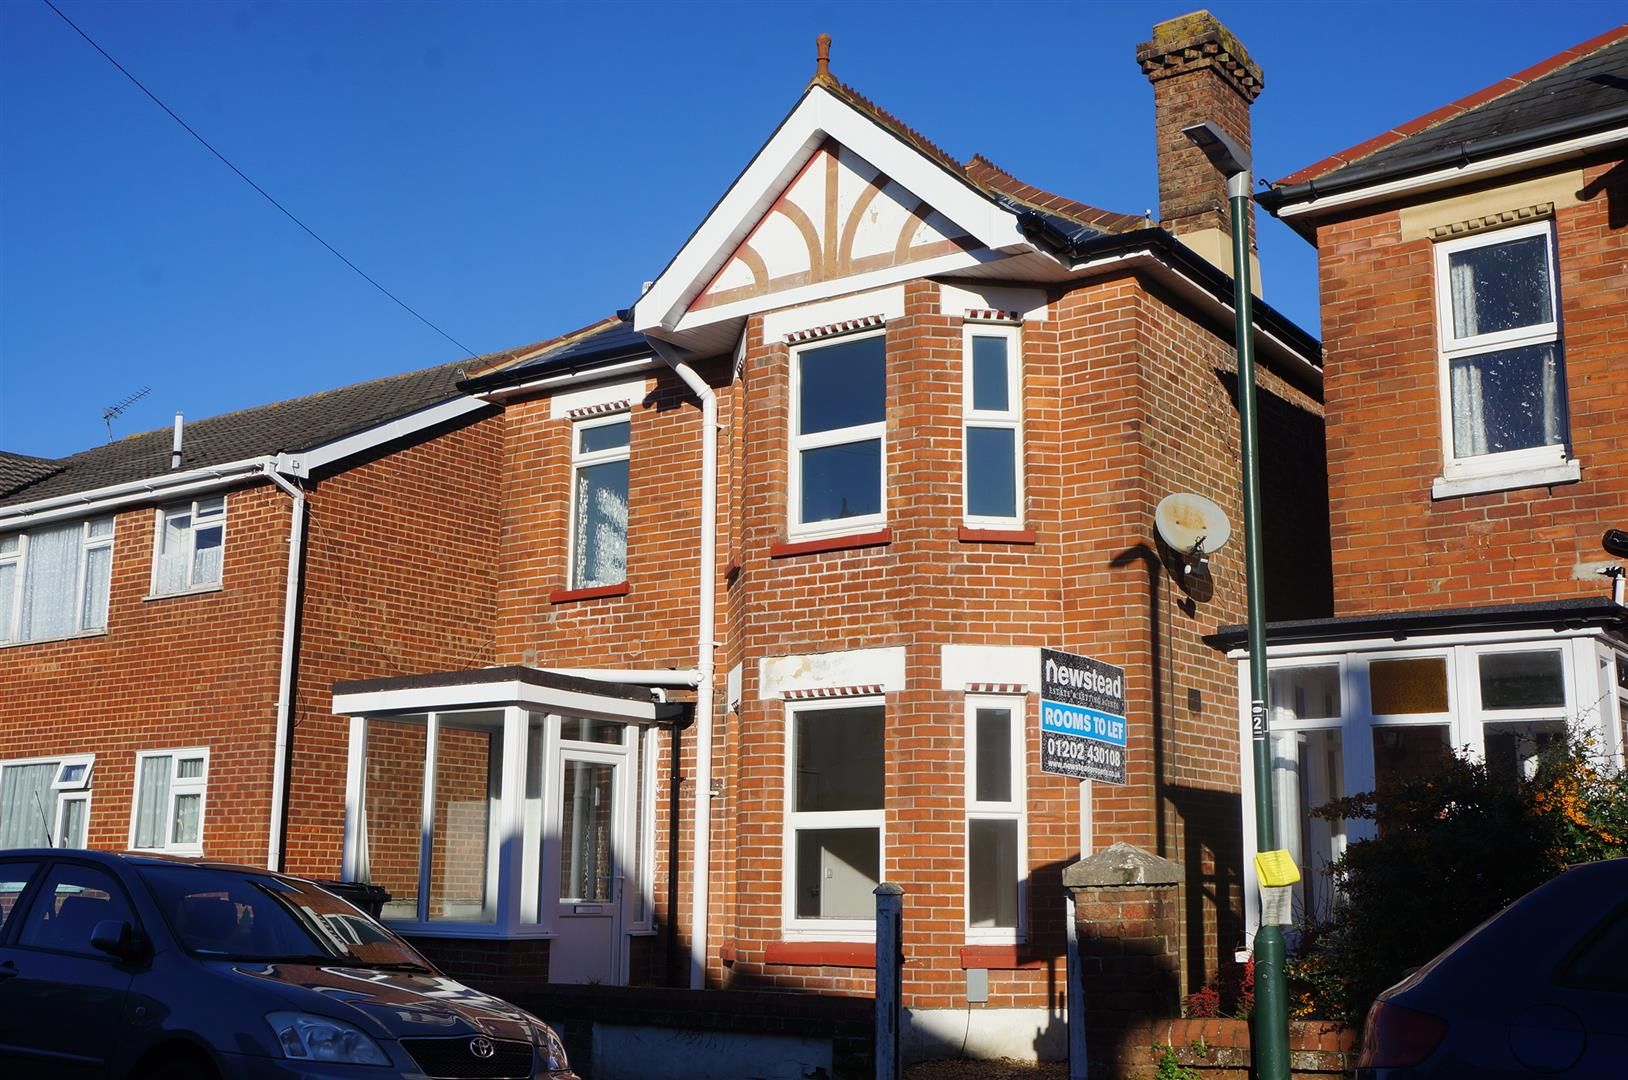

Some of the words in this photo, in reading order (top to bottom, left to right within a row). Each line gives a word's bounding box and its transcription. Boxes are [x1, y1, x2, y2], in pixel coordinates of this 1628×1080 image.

[1045, 658, 1121, 698] newstead
[1045, 707, 1091, 732] ROOMS
[1093, 717, 1106, 736] TO
[1107, 720, 1123, 739] LET
[1047, 738, 1085, 760] 01202
[1087, 745, 1120, 767] 430108
